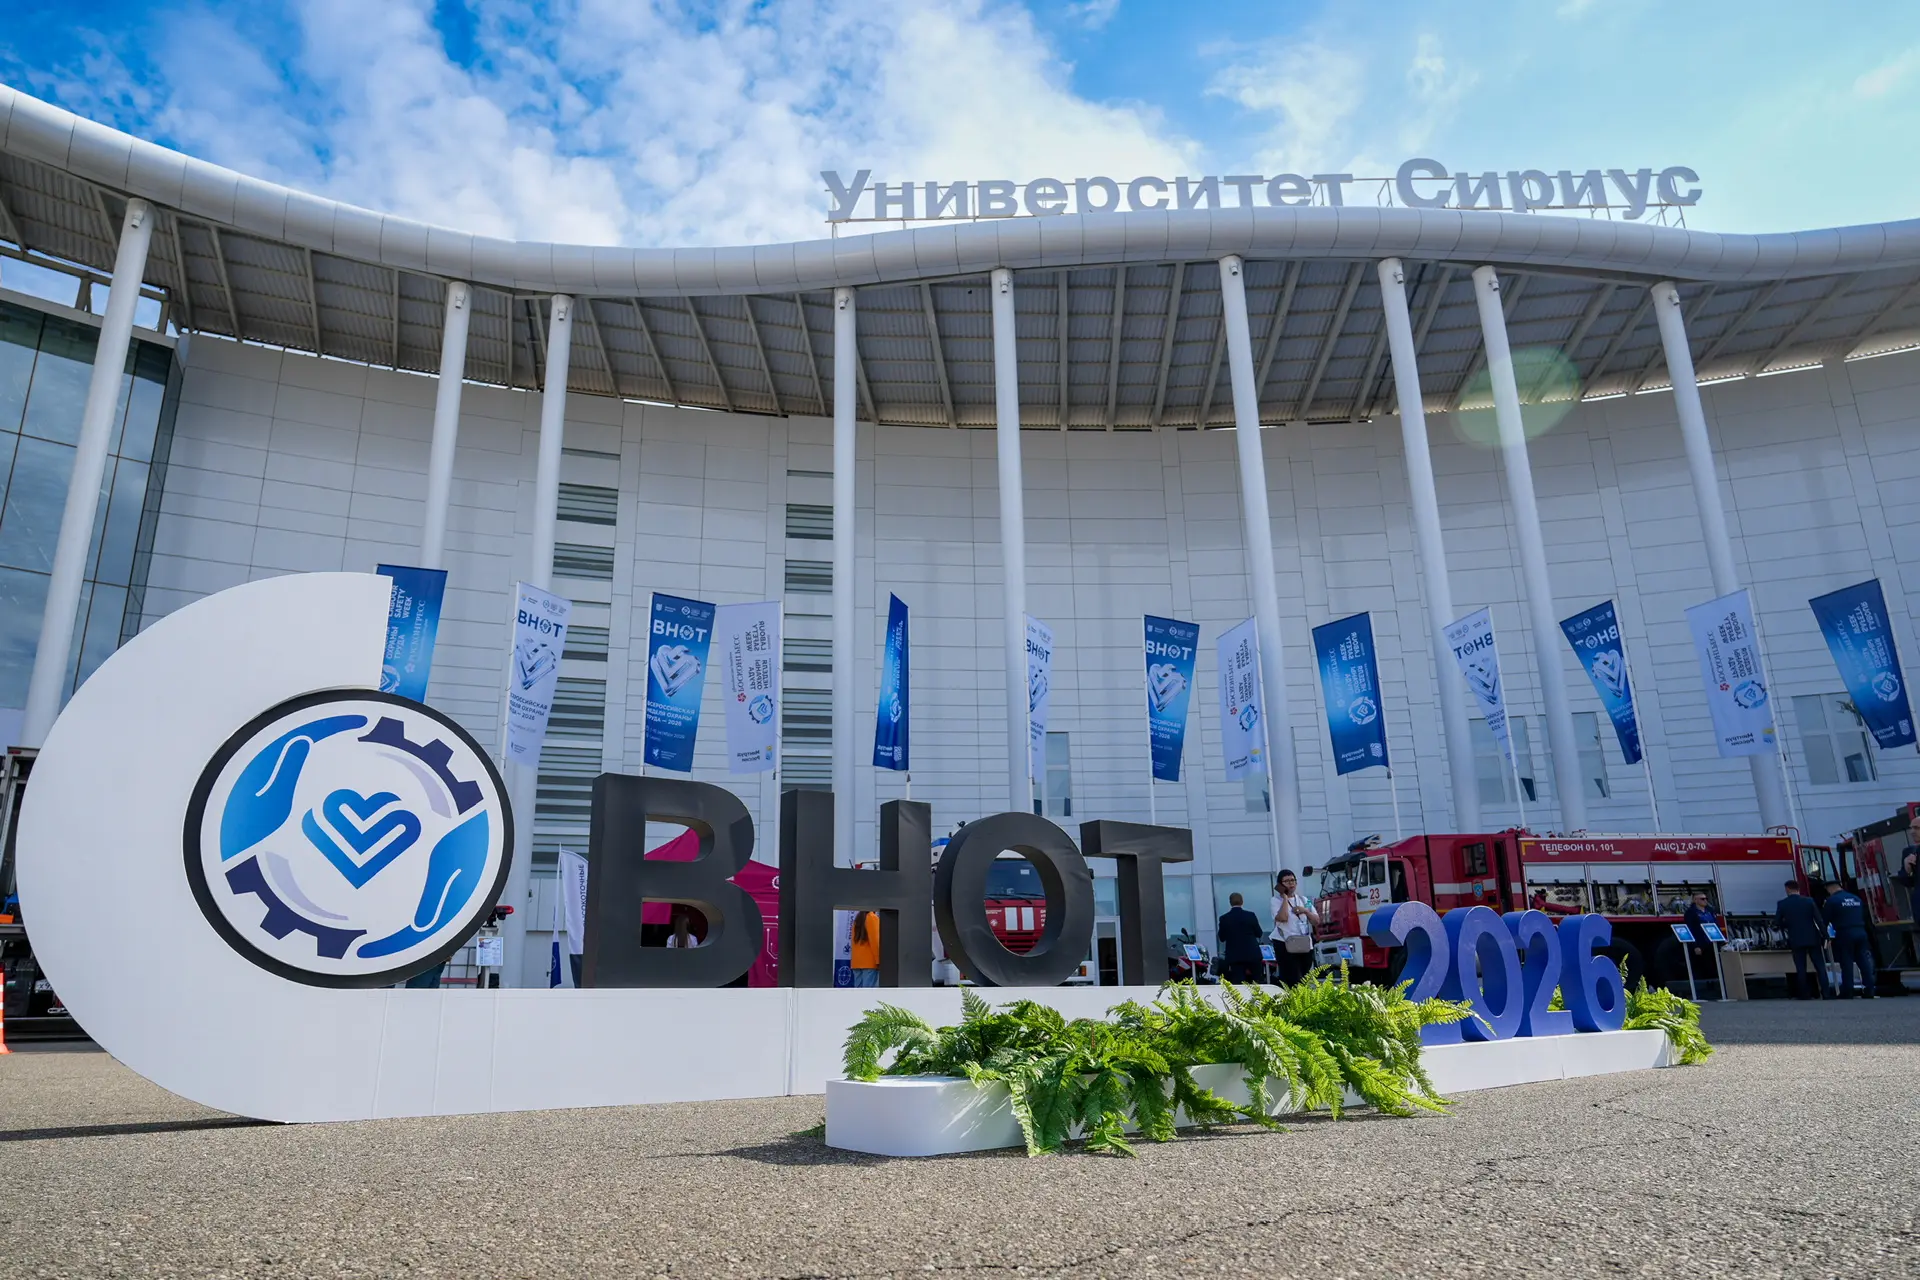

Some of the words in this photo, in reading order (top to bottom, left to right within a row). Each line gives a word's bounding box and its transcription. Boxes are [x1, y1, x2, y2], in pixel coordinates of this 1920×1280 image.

[820, 169, 1353, 221] Университет
[1396, 158, 1703, 220] Сириус
[394, 588, 406, 618] SAFETY
[402, 596, 413, 619] WEEK
[518, 609, 563, 638] ВНОТ
[652, 618, 708, 643] ВНОТ
[386, 626, 399, 660] ОХРАНЫ
[394, 634, 406, 660] ТРУДА
[1026, 638, 1050, 663] ВНОТ
[1146, 639, 1193, 661] ВНОТ
[666, 712, 693, 722] ОХРАНЫ
[1540, 843, 1583, 852] ТЕЛЕФОН
[1585, 843, 1598, 853] 01,
[1600, 843, 1615, 851] 101
[1654, 842, 1680, 852] АЦ(С)
[1681, 842, 1706, 852] 7,0-70
[583, 773, 1193, 989] ВНОТ
[1370, 888, 1380, 900] 23
[1366, 900, 1627, 1046] 2026
